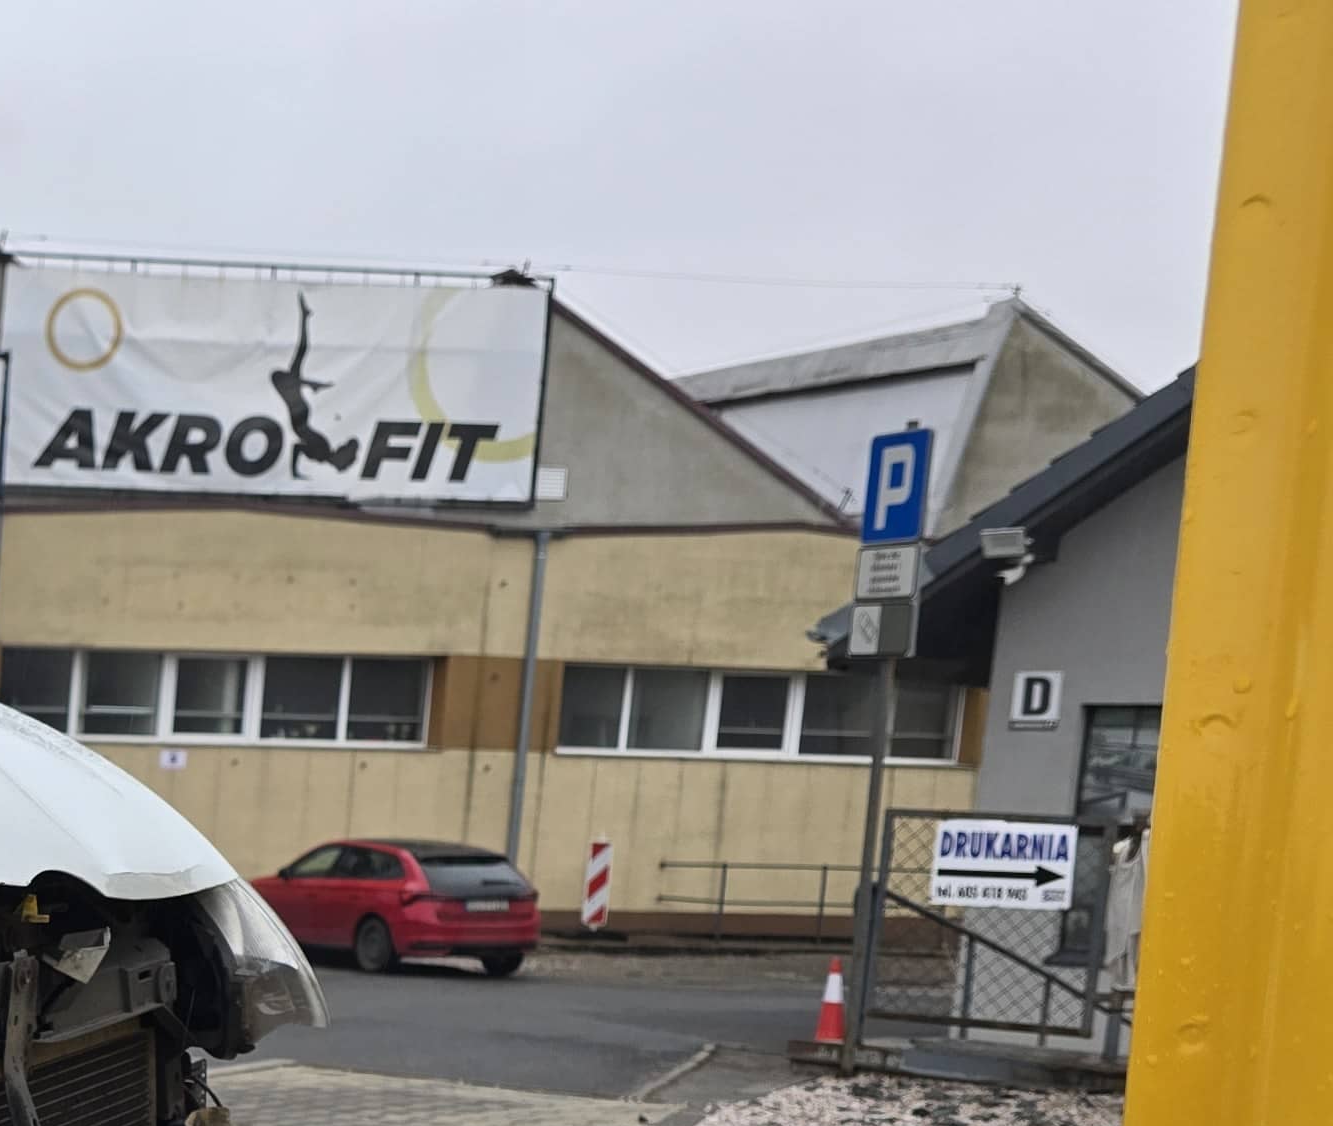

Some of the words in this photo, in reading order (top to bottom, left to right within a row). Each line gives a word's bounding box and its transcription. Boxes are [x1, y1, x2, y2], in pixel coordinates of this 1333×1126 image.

[872, 444, 917, 531] P
[1021, 677, 1051, 716] D
[940, 830, 1069, 862] DRUKARNIA
